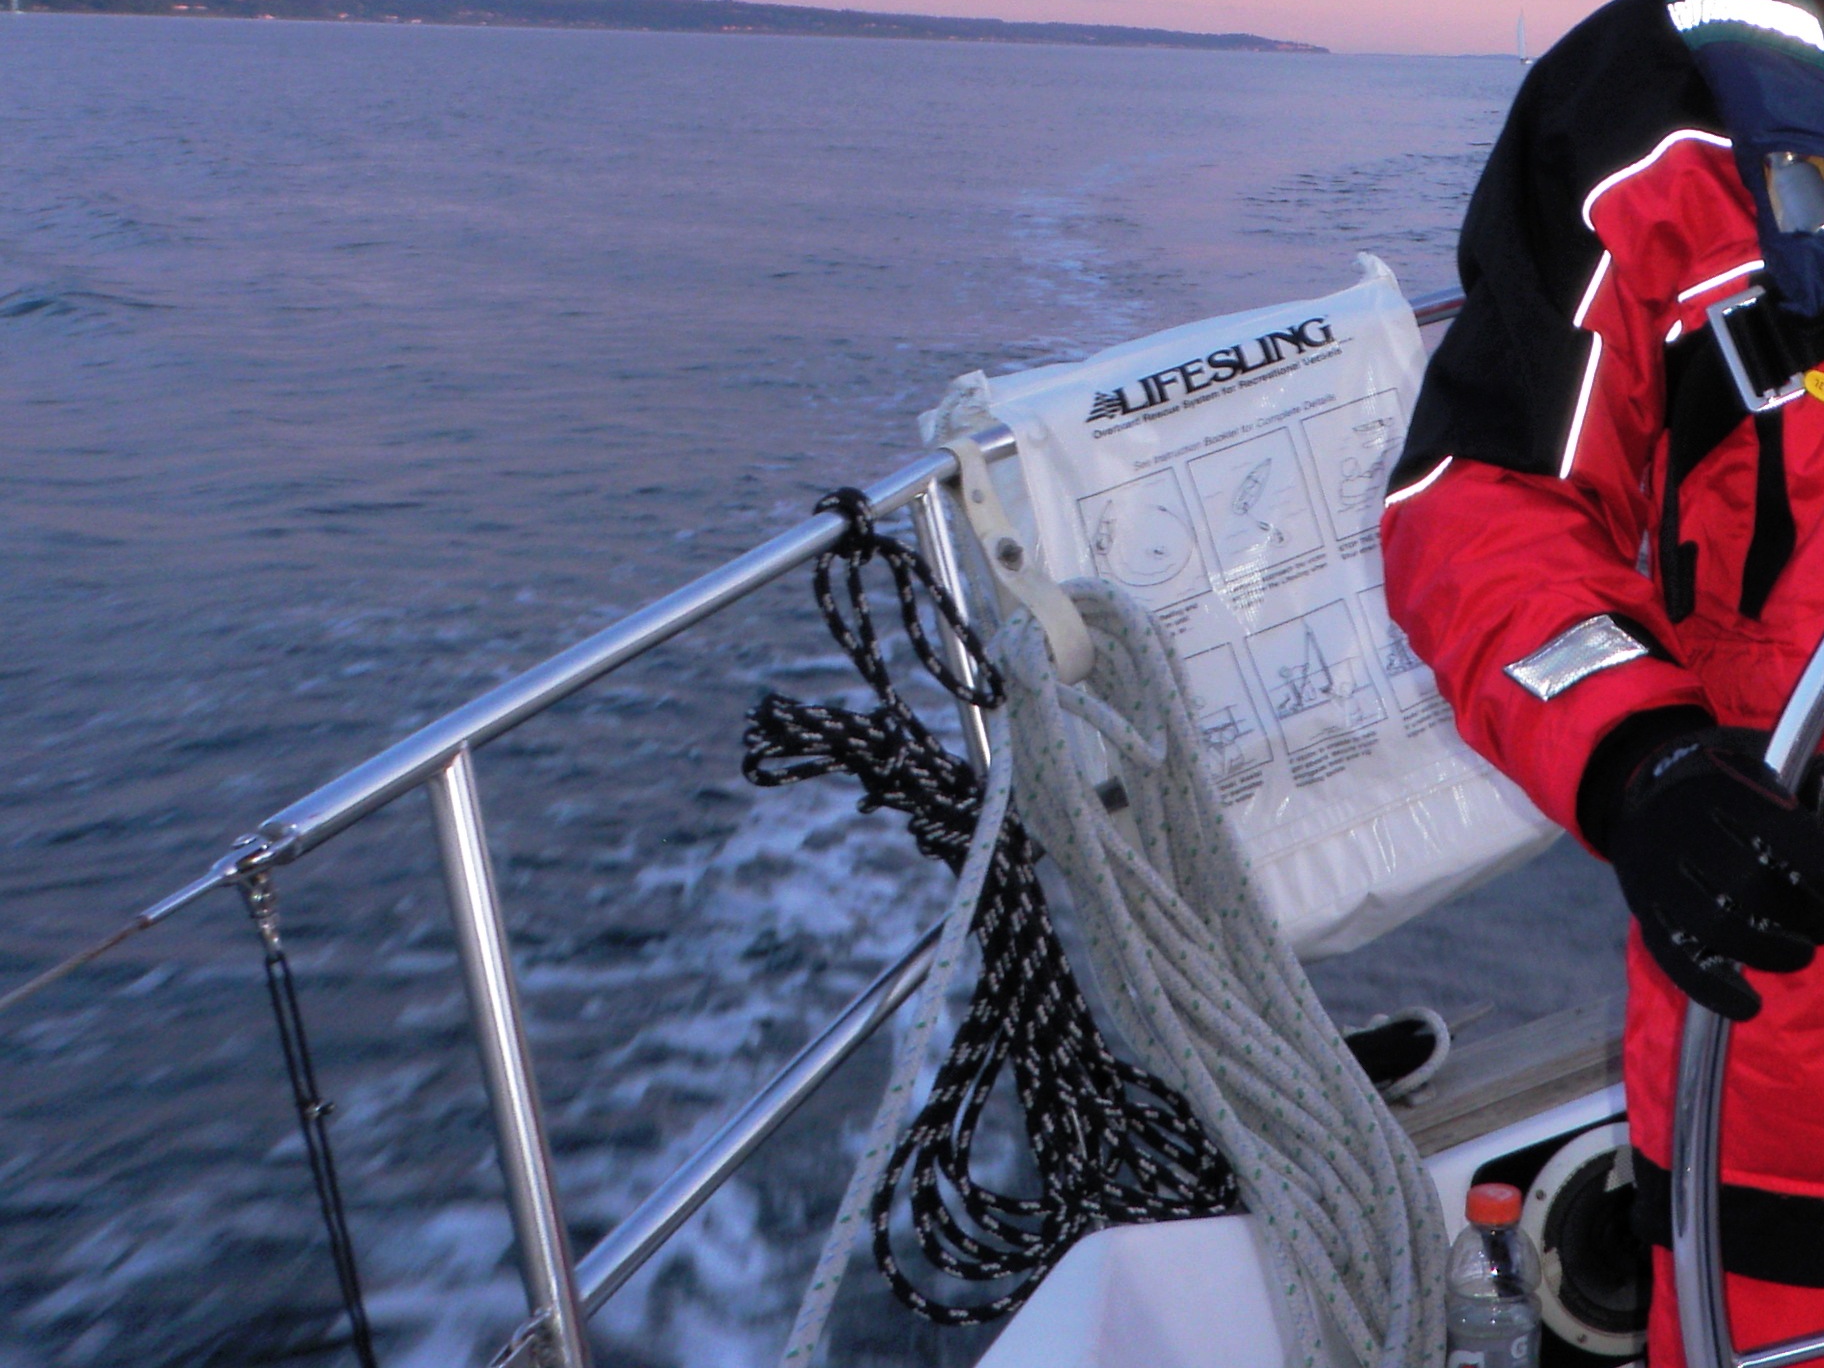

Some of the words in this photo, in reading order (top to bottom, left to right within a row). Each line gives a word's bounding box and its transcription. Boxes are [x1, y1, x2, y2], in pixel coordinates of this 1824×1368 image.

[1113, 318, 1336, 415] LIFESLING
[1143, 405, 1180, 423] Rescue
[1183, 391, 1219, 410] System
[1222, 385, 1237, 398] for
[1239, 364, 1299, 390] Recreational
